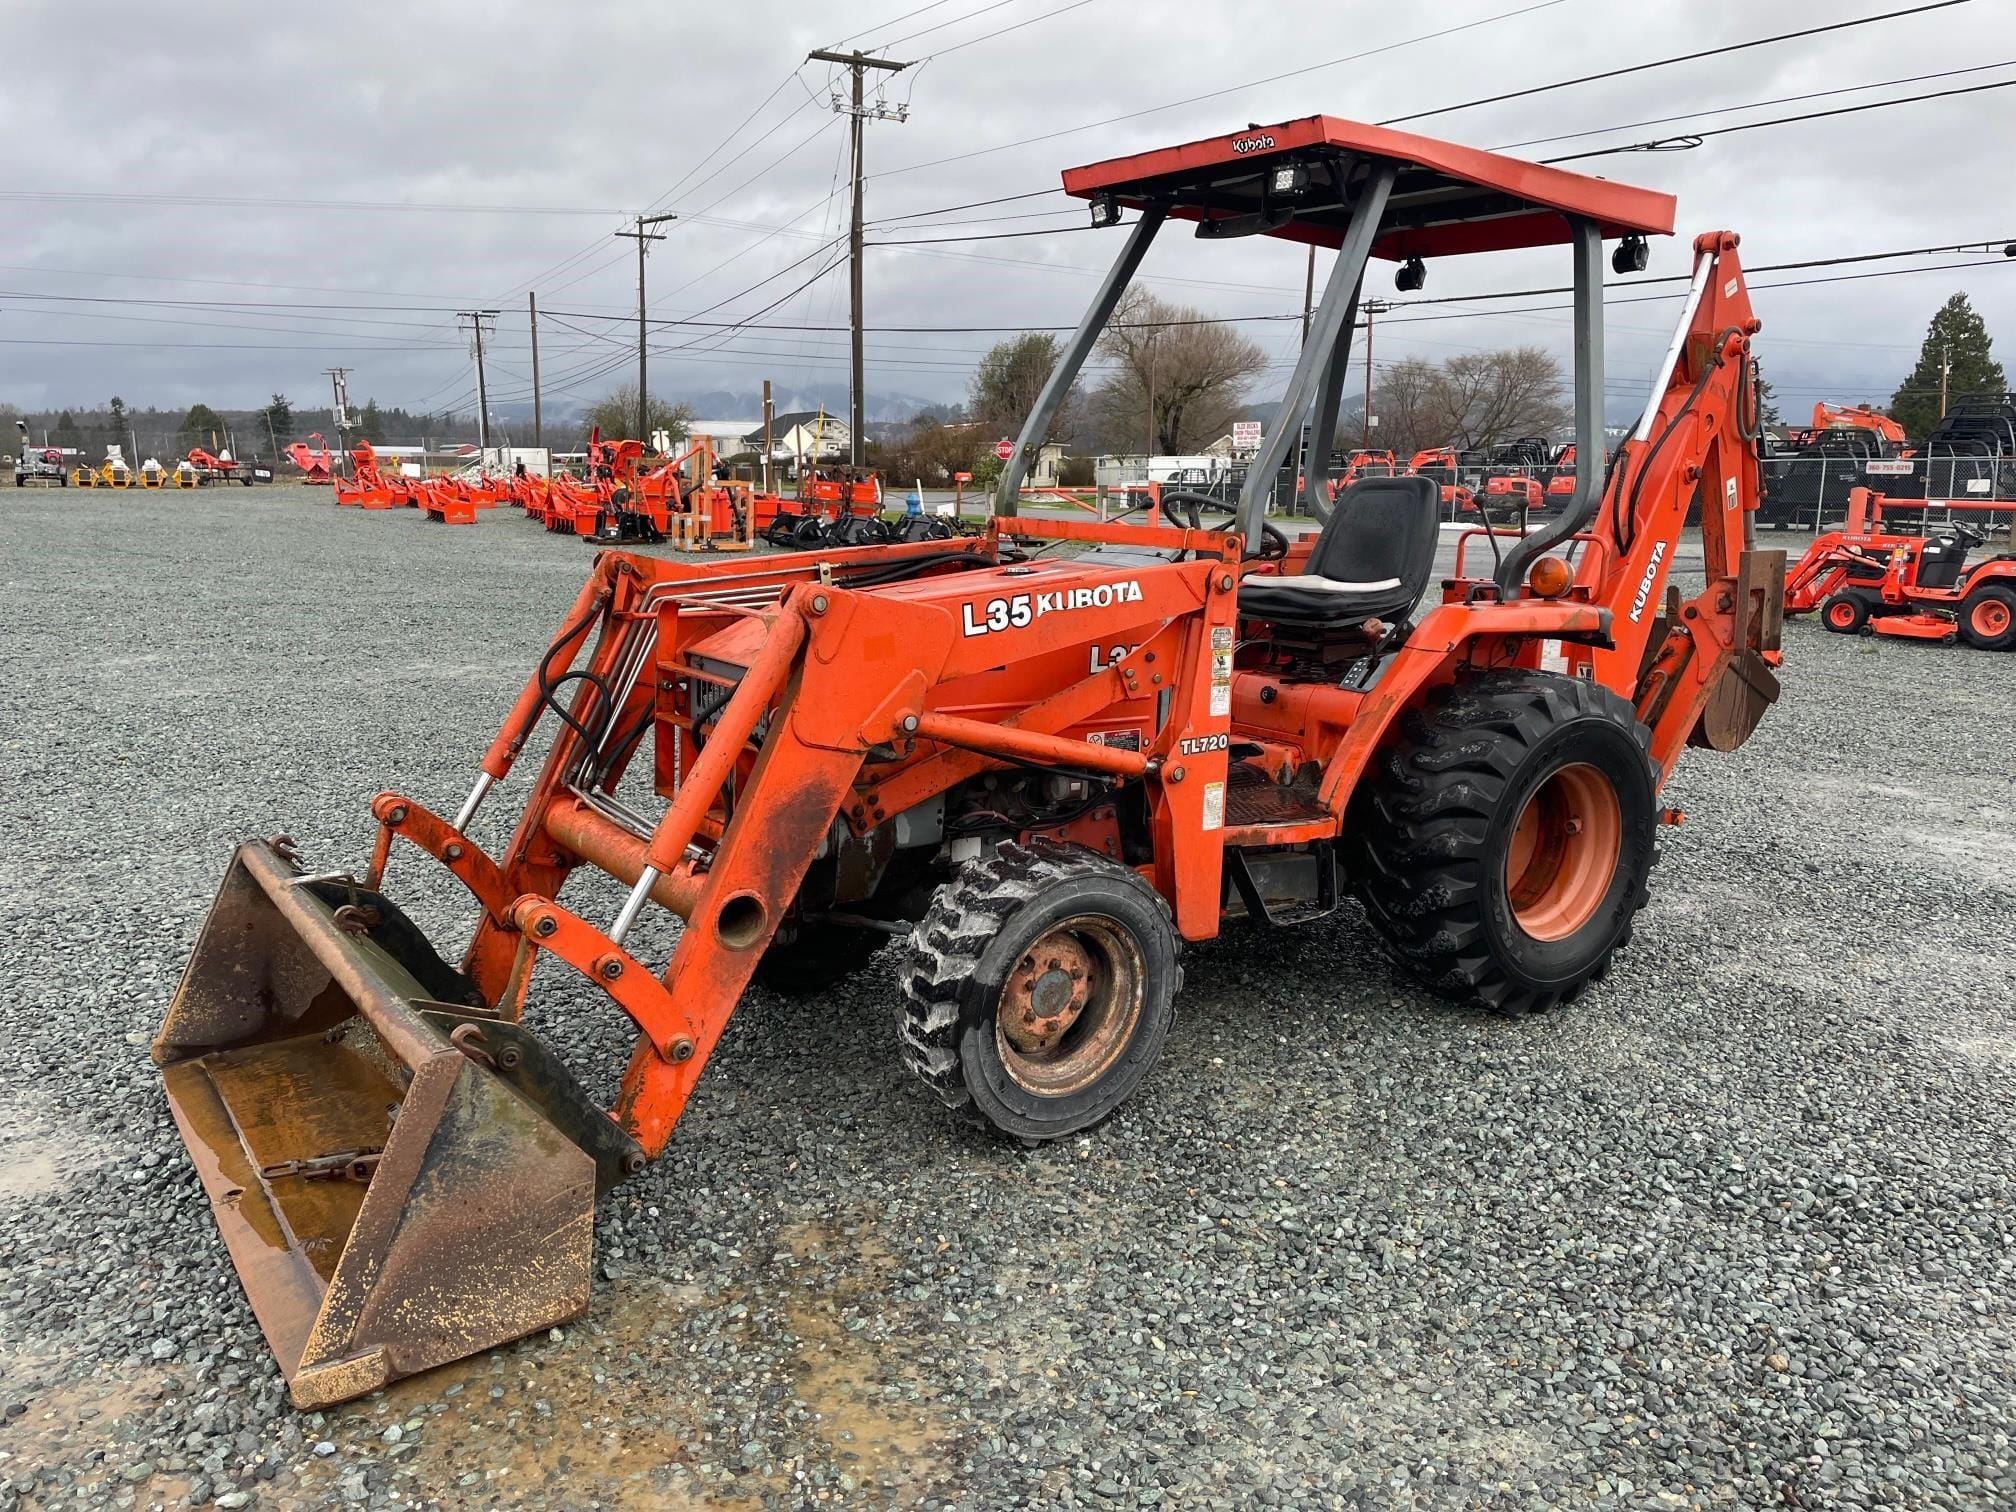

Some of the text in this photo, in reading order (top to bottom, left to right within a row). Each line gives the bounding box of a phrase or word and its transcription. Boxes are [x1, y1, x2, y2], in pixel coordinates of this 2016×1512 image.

[1232, 134, 1275, 154] Kubota
[997, 446, 1013, 454] STOP
[1629, 541, 1667, 624] KUBOTA
[962, 580, 1144, 638] L35 KUBOTA
[1089, 644, 1142, 675] L3
[1180, 734, 1229, 756] TL720
